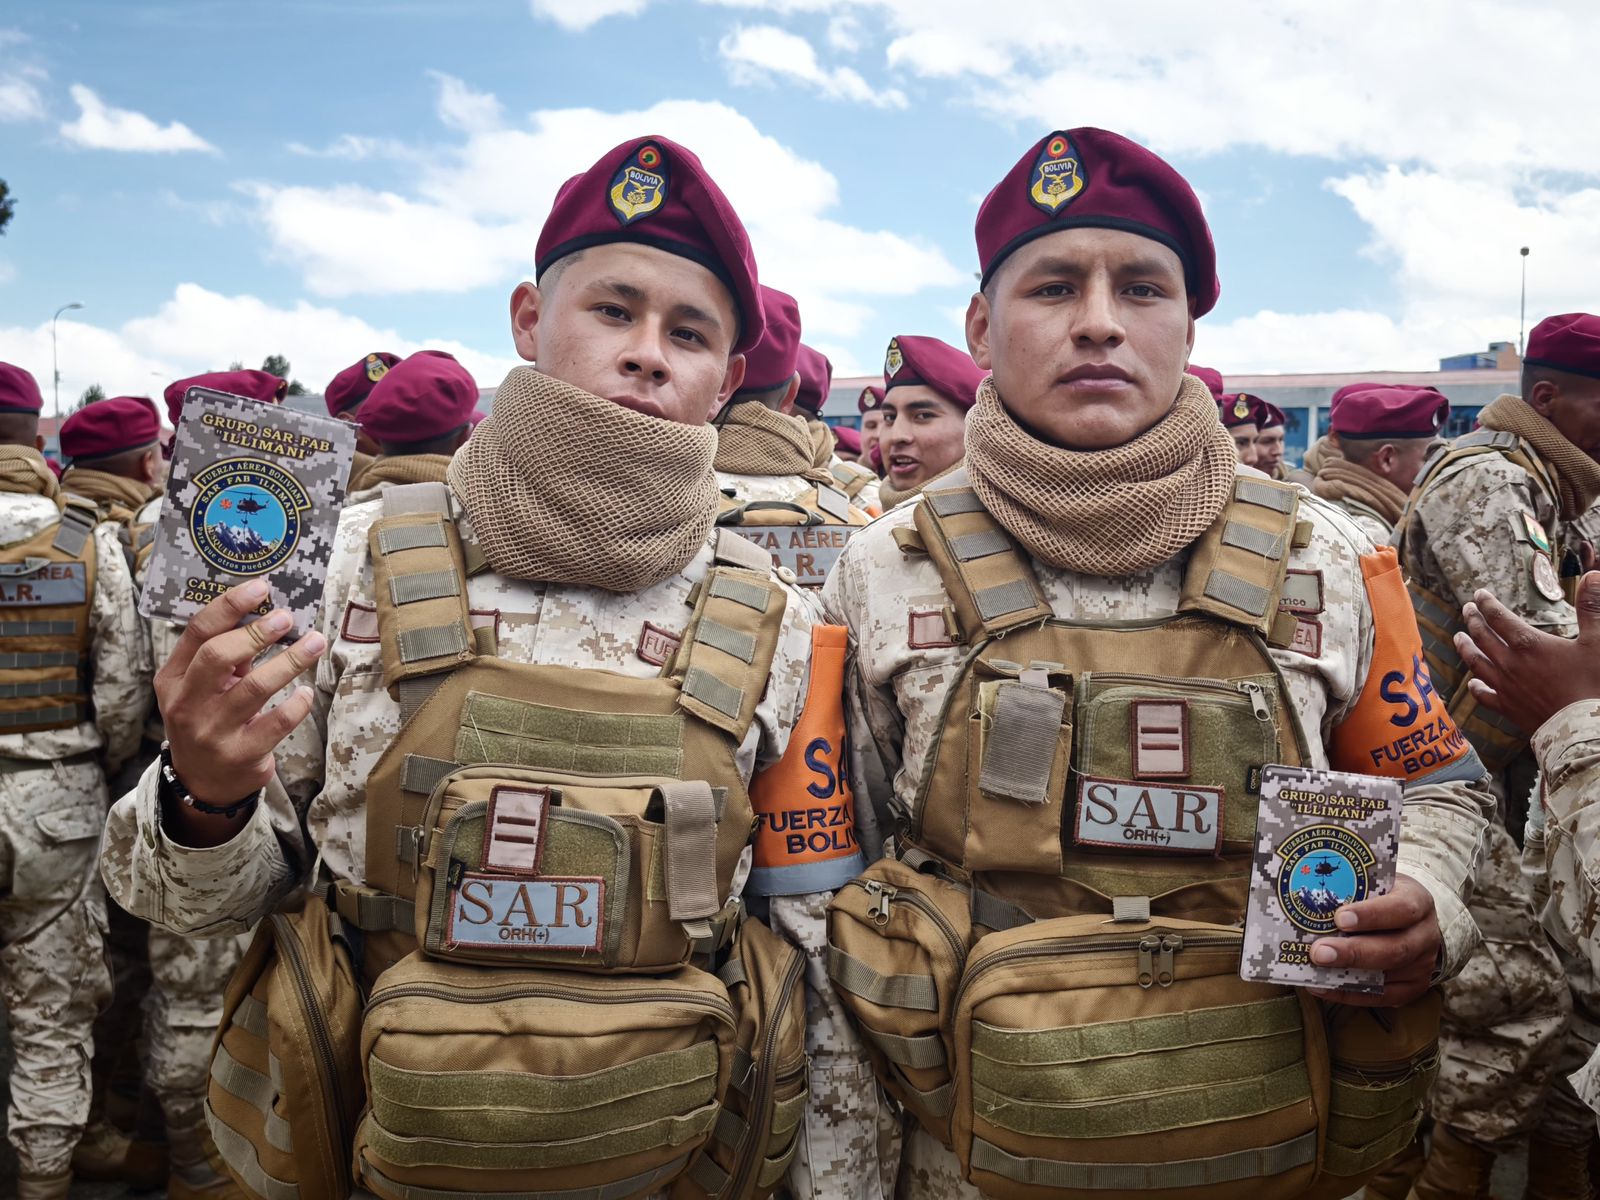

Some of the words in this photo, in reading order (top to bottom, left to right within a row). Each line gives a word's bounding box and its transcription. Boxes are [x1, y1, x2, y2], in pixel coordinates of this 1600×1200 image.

[630, 170, 658, 185] BOLIVIA
[1044, 161, 1073, 173] BOLIVIA
[202, 414, 258, 435] GRUPO
[216, 430, 313, 459] "ILLIMANI"
[201, 464, 235, 485] FUERZA
[268, 468, 304, 506] BOLIVIANA
[201, 484, 221, 504] SAR
[226, 475, 251, 485] FAB
[789, 528, 850, 549] AÉRE
[204, 545, 217, 558] que
[217, 558, 239, 570] otros
[241, 560, 272, 571] puedan
[1370, 717, 1450, 768] FUERZA
[1085, 784, 1212, 834] SAR
[1280, 790, 1325, 803] GRUPO
[757, 804, 852, 833] FUERZA
[1291, 803, 1372, 820] "ILLIMANI"
[1283, 833, 1310, 854] FUERZA
[1338, 832, 1369, 862] BOLIVIANA
[1285, 853, 1301, 871] SAR
[1304, 841, 1324, 852] FAB
[459, 880, 592, 928] SAR
[498, 927, 550, 945] ORH(+)
